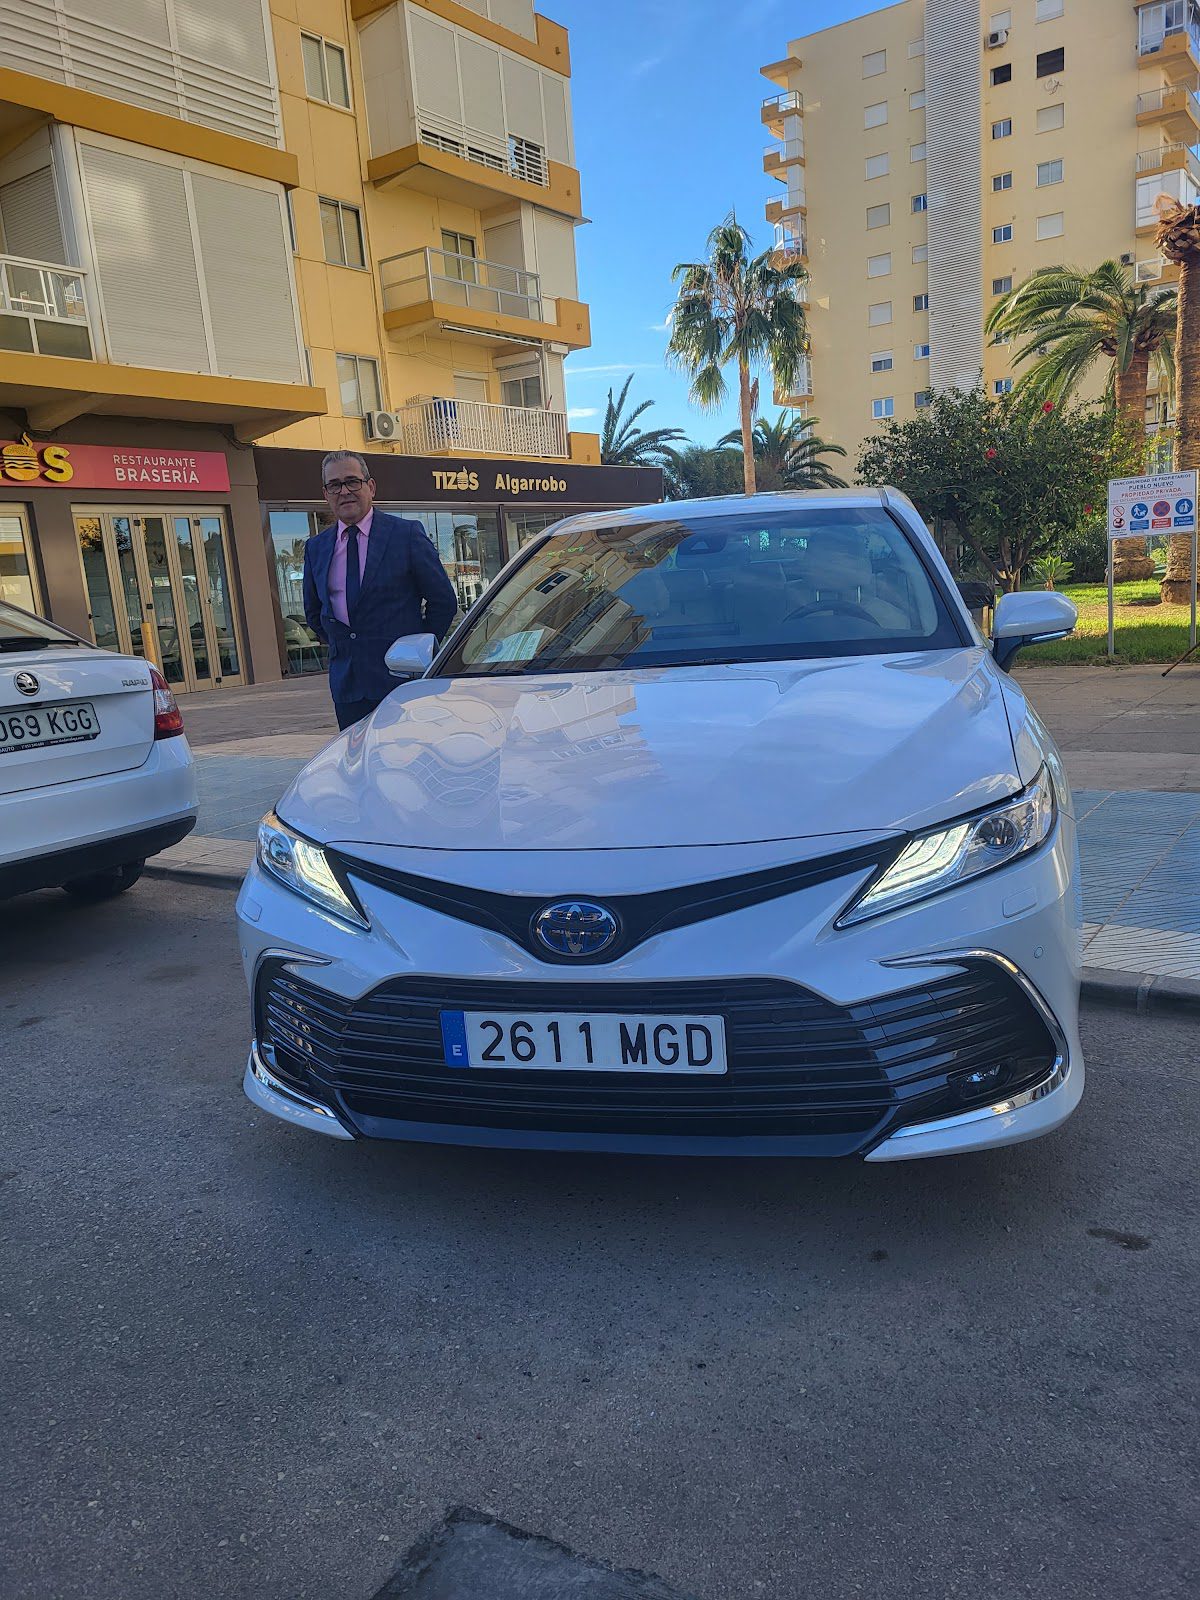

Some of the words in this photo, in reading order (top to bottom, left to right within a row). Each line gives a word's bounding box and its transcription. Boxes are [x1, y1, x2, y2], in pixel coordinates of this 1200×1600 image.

[0, 436, 74, 483] OS
[113, 454, 196, 468] RESTAURANTE
[115, 466, 200, 484] BRASERÍA
[432, 466, 479, 491] TIZOS
[495, 473, 567, 495] Algarrobo
[1121, 490, 1155, 498] PROPIEDAD
[1156, 487, 1182, 495] PRIVADA
[1128, 483, 1152, 491] PUEBLO
[121, 678, 149, 687] RAPID
[46, 708, 92, 735] KGG
[452, 1045, 463, 1057] E
[479, 1020, 594, 1064] 2611
[619, 1022, 713, 1067] MGD
